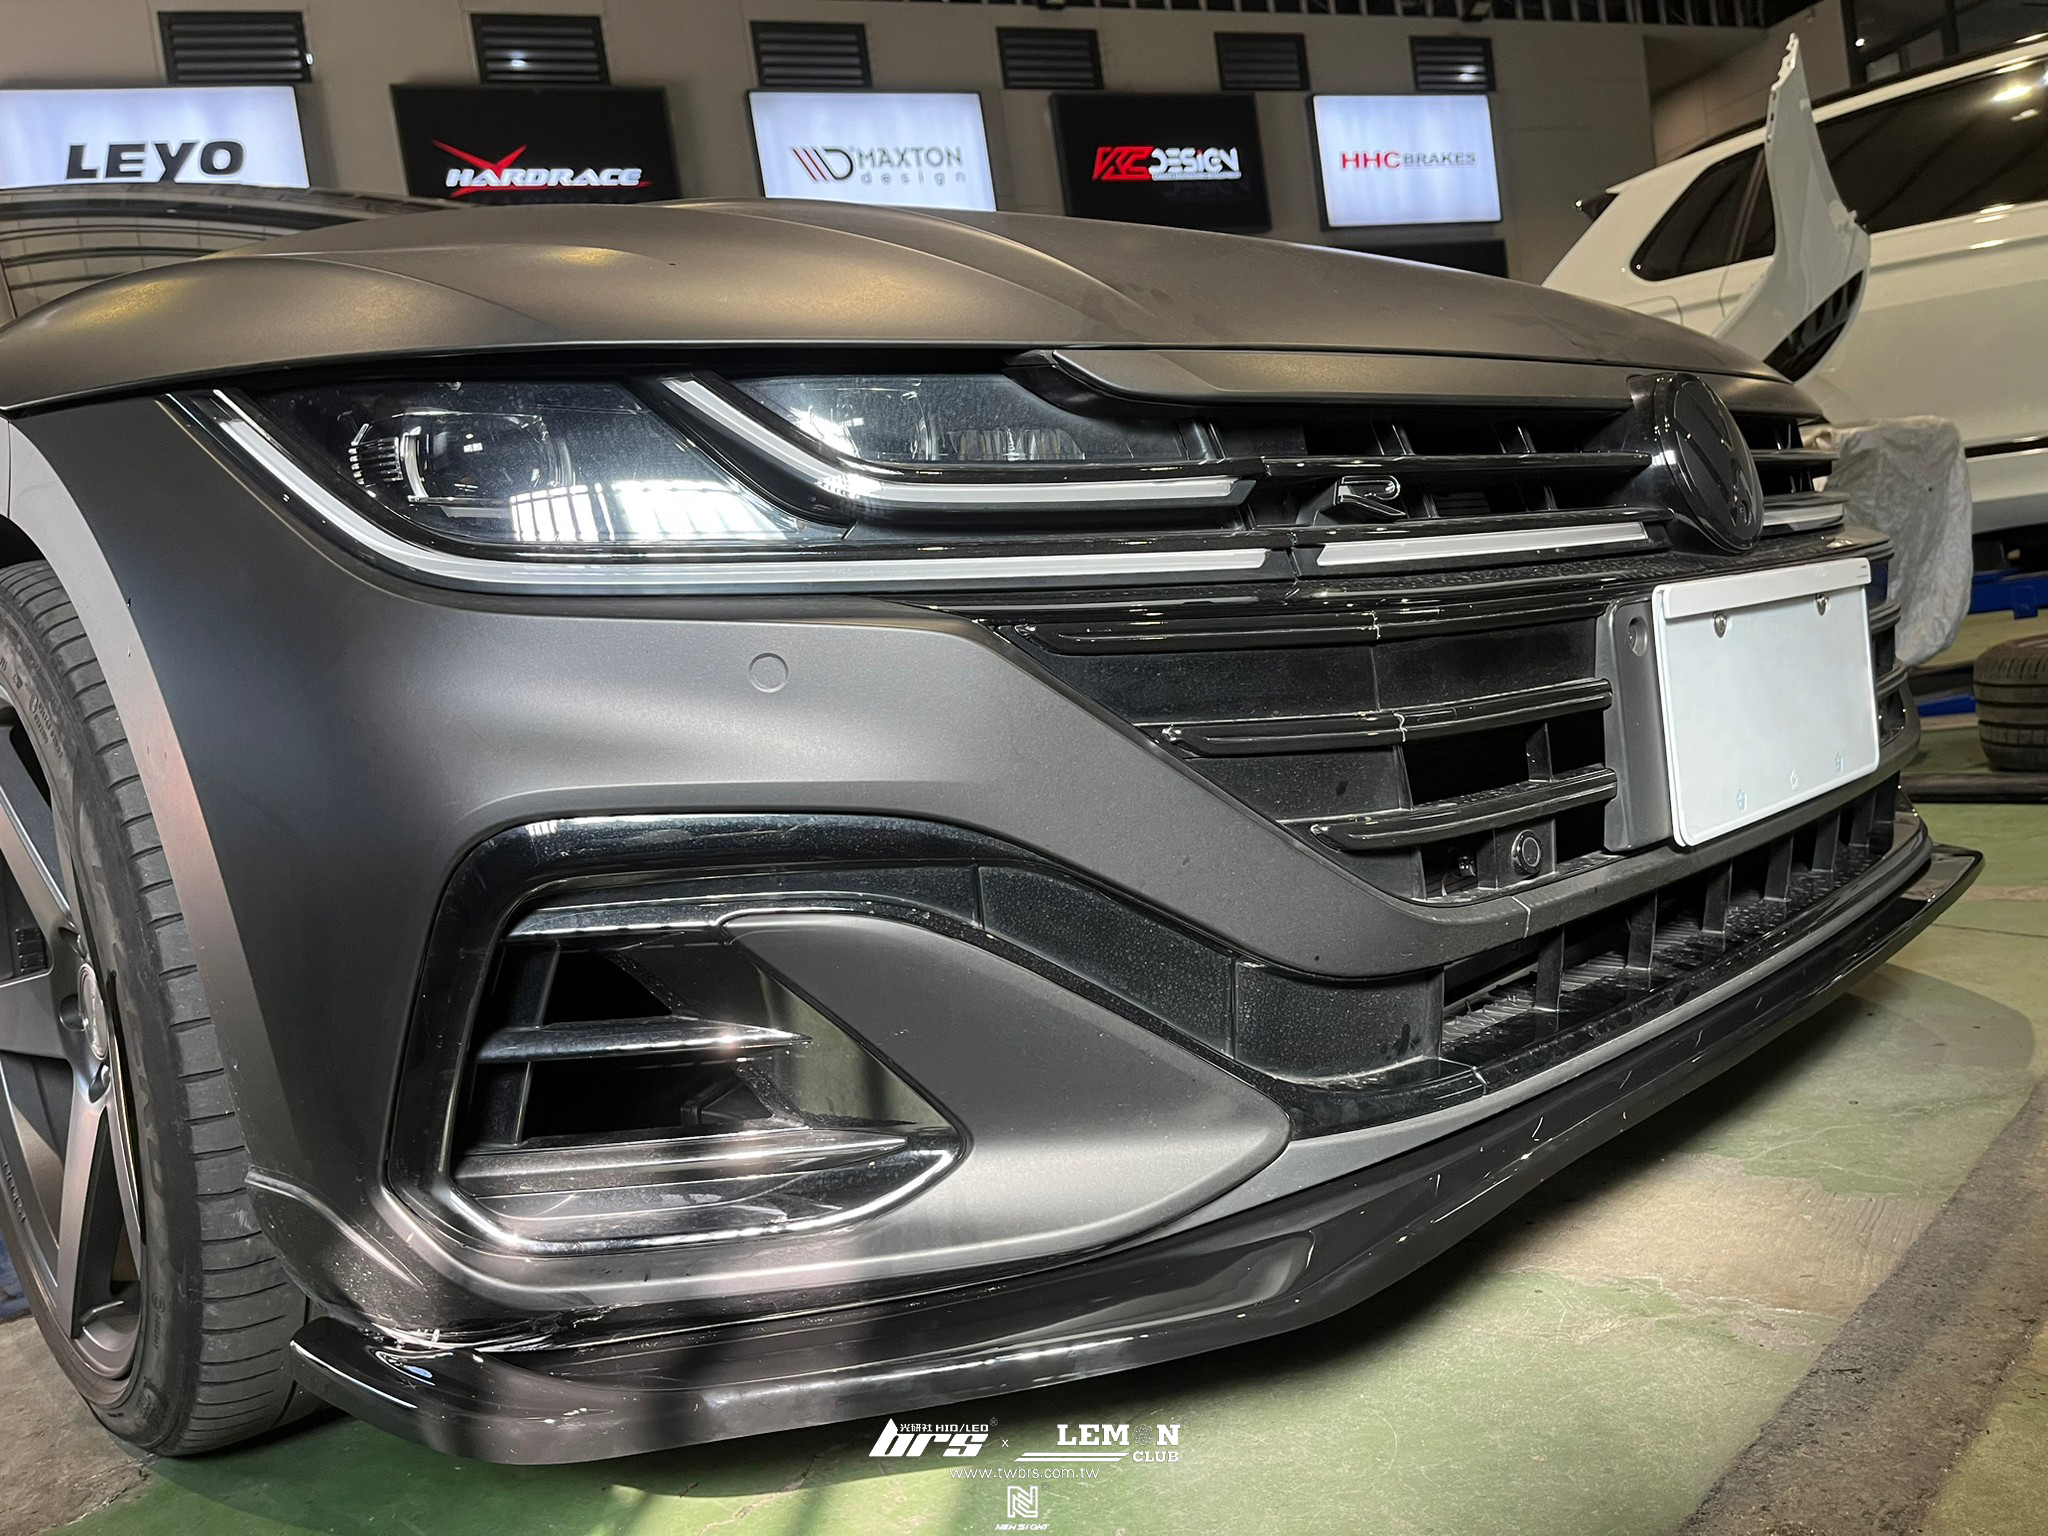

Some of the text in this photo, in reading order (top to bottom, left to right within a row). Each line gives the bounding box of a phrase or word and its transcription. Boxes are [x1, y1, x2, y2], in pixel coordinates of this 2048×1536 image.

[66, 141, 244, 184] LEYO
[857, 147, 964, 168] MAXTON
[1341, 152, 1476, 169] HHC BRAKES
[446, 168, 642, 187] HARDRACE
[860, 170, 966, 187] design
